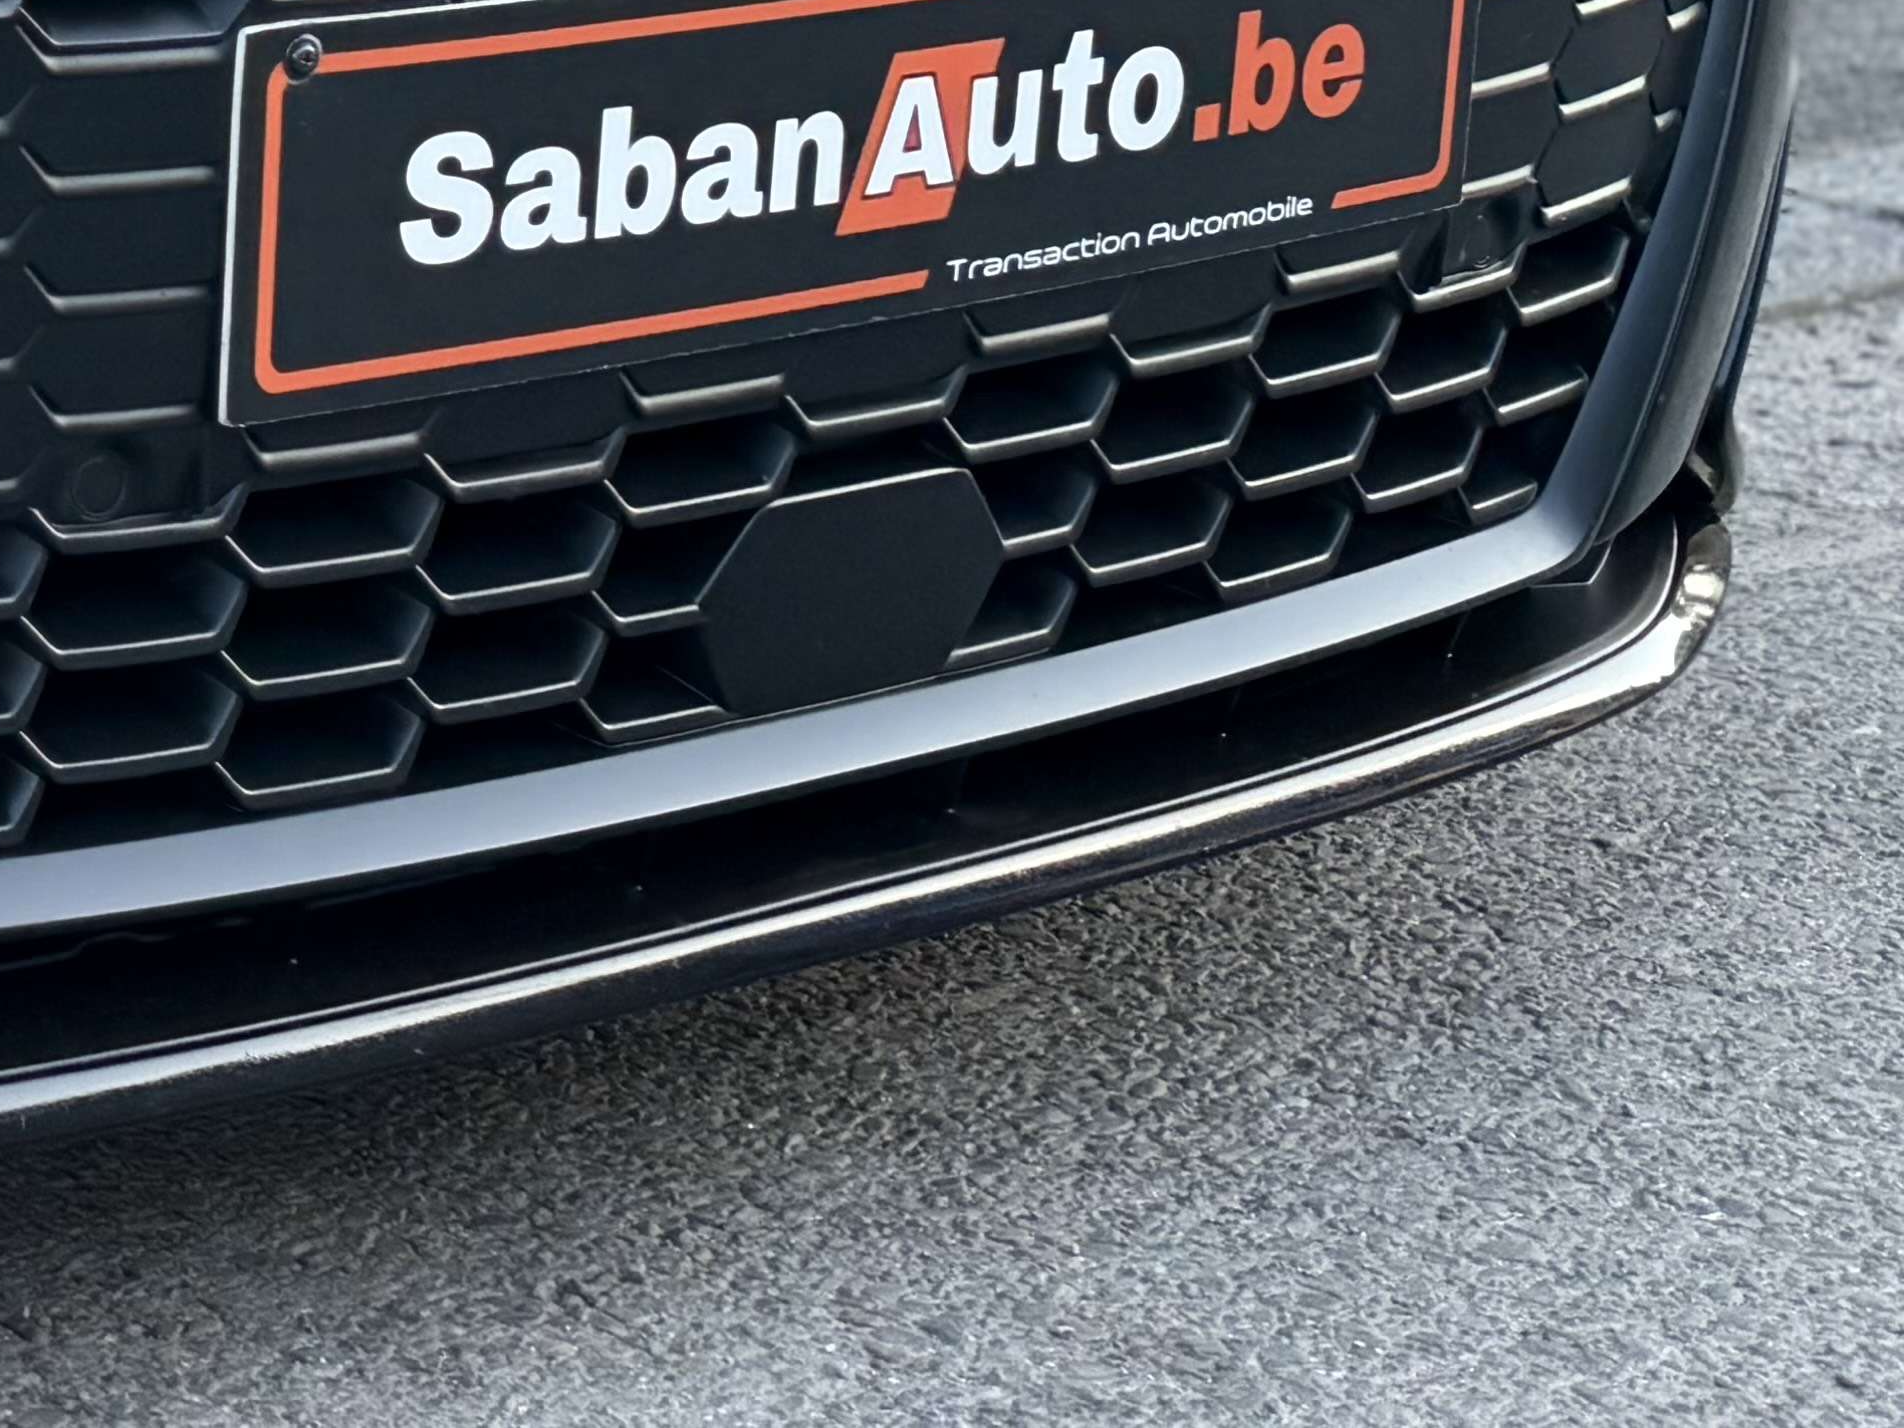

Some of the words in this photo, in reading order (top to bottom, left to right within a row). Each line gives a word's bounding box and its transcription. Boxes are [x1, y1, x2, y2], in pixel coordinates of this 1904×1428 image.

[398, 10, 1366, 266] SabanAuto.be
[946, 230, 1141, 283] Transaction
[1146, 194, 1314, 247] Automobile
